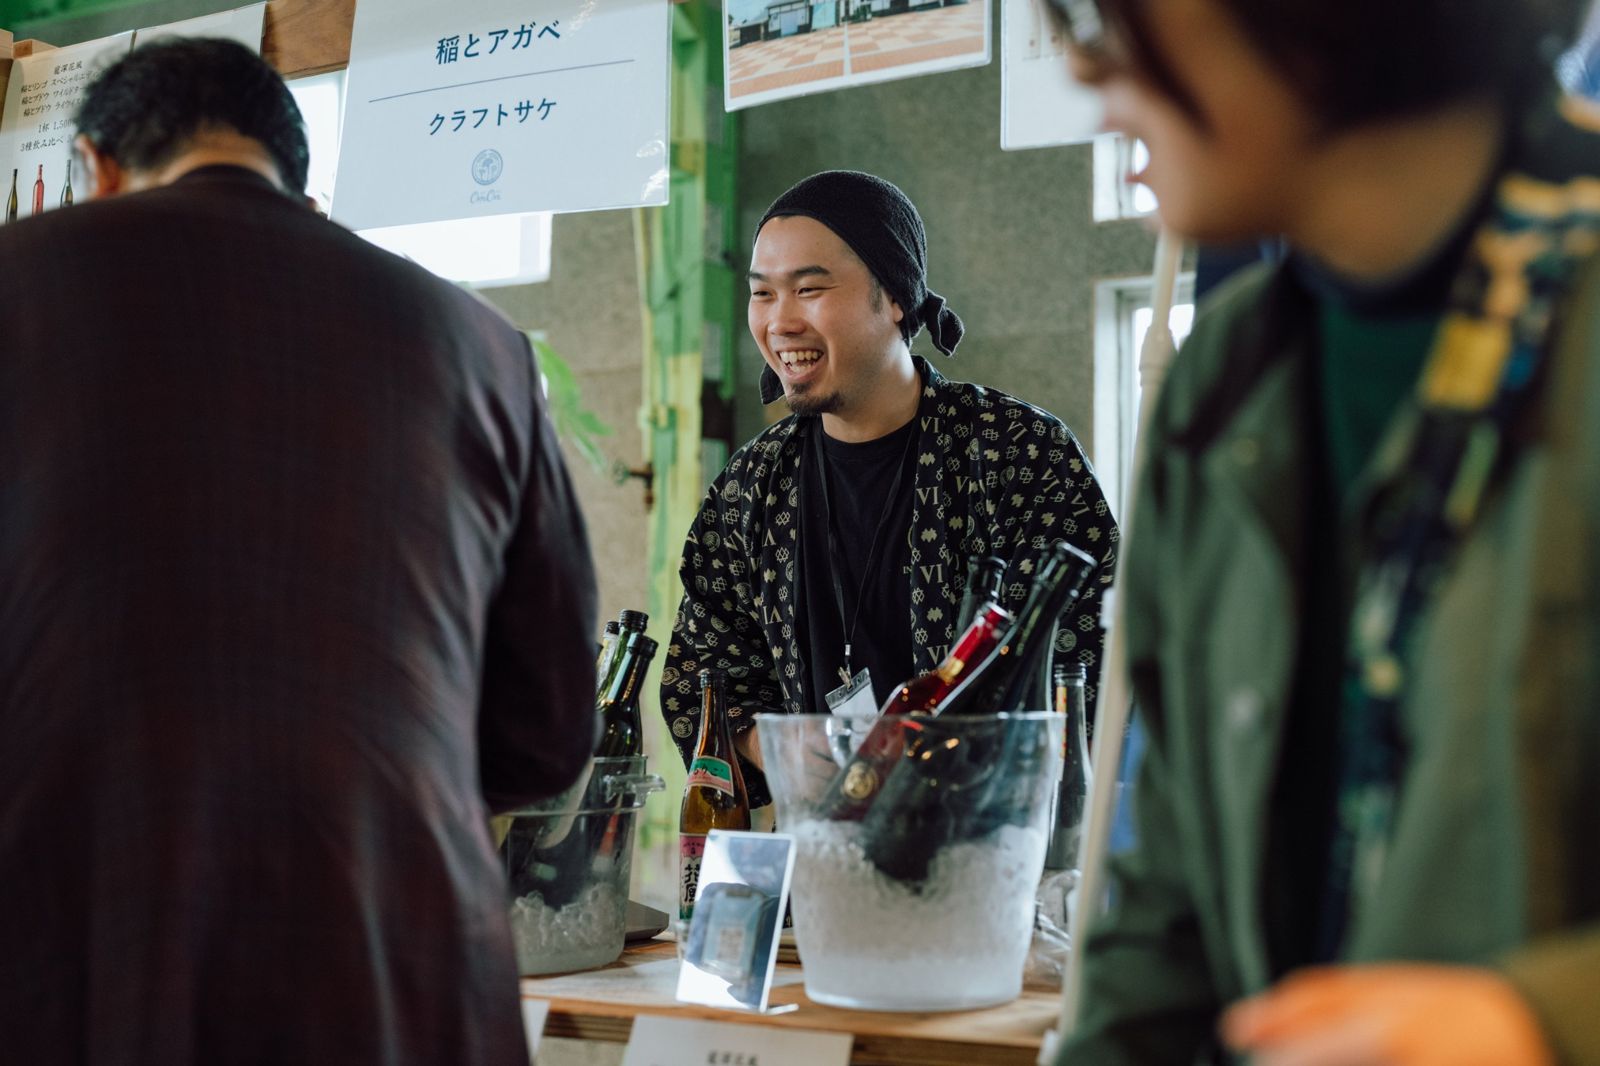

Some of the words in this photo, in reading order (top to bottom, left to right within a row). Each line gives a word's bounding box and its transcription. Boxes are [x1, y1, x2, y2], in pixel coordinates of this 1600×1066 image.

[435, 20, 560, 65] 稲とアガベ
[430, 98, 557, 135] クラフトサケ
[917, 486, 939, 505] VI
[920, 564, 943, 584] VI
